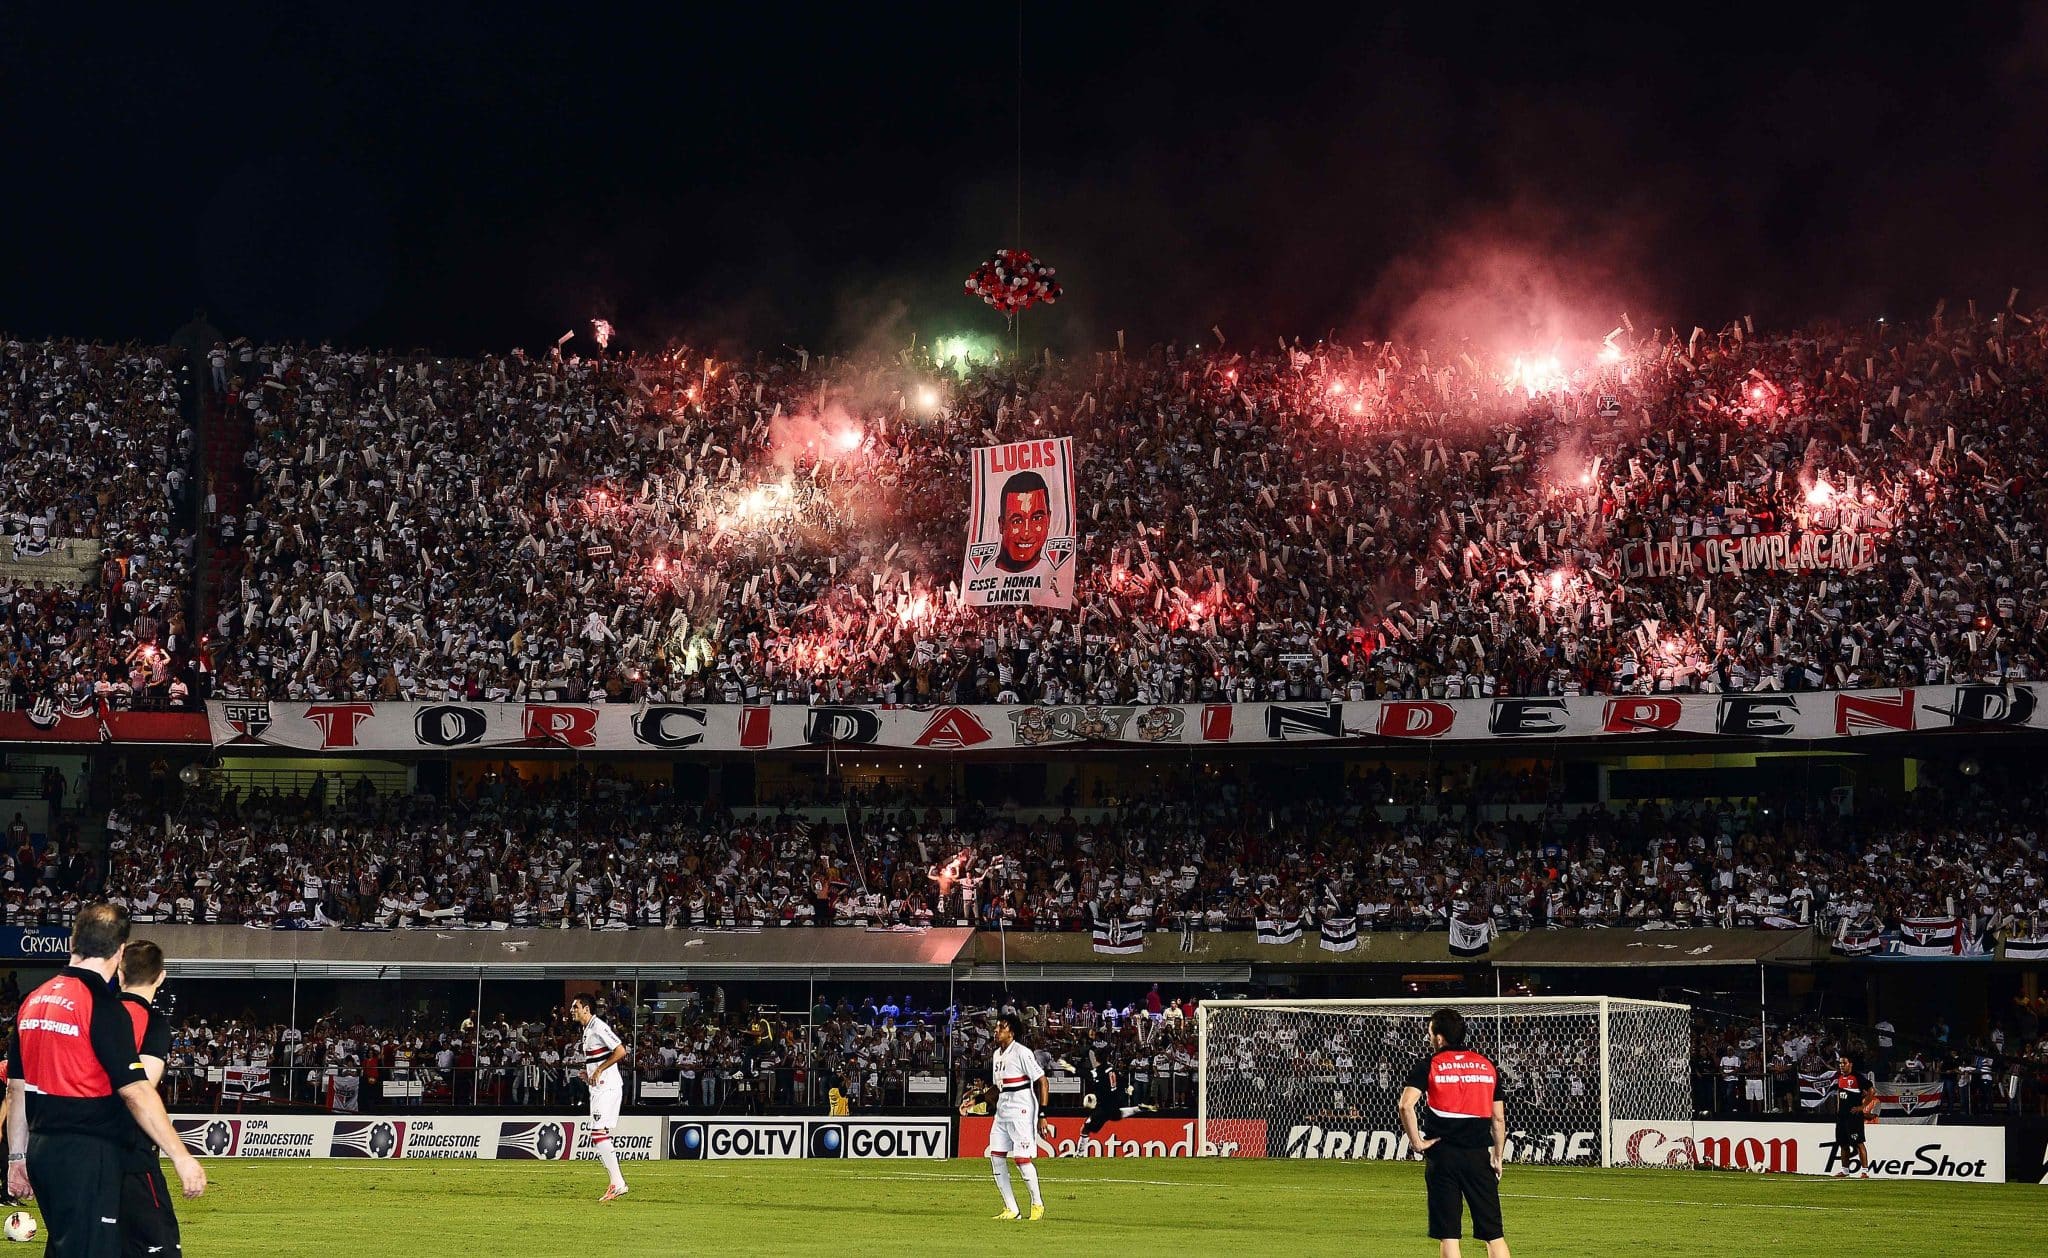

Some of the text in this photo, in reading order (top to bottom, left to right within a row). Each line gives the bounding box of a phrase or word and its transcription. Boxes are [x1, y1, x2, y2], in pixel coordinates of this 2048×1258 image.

[990, 440, 1056, 474] LUCAS
[972, 545, 996, 556] SPFC
[1047, 538, 1072, 550] SPFC
[1706, 538, 1741, 576] OS
[968, 575, 1042, 591] ESSE HONRA
[987, 589, 1030, 602] CAMISA
[226, 707, 268, 721] SPFC
[305, 702, 994, 751] TORCIDA
[20, 935, 70, 953] CRYSTAL
[39, 1018, 79, 1036] TOSHIBA
[1437, 1060, 1452, 1072] SÃO
[1452, 1061, 1475, 1070] PAULO
[1434, 1074, 1495, 1084] SEMP TOSHIBA
[246, 1119, 269, 1129] COPA
[411, 1121, 434, 1131] COPA
[243, 1131, 315, 1146] BRIDGESTONE
[408, 1133, 481, 1148] BRIDGESTONE
[711, 1129, 798, 1157] GOLTV
[852, 1129, 943, 1157] GOLTV
[1036, 1121, 1239, 1158] Santander
[241, 1147, 312, 1158] SUDAMERICANA
[406, 1149, 478, 1160] SUDAMERICANA
[575, 1151, 650, 1161] SUDARICANA
[1625, 1128, 1798, 1173] Canon
[1819, 1141, 1987, 1178] PowerShot
